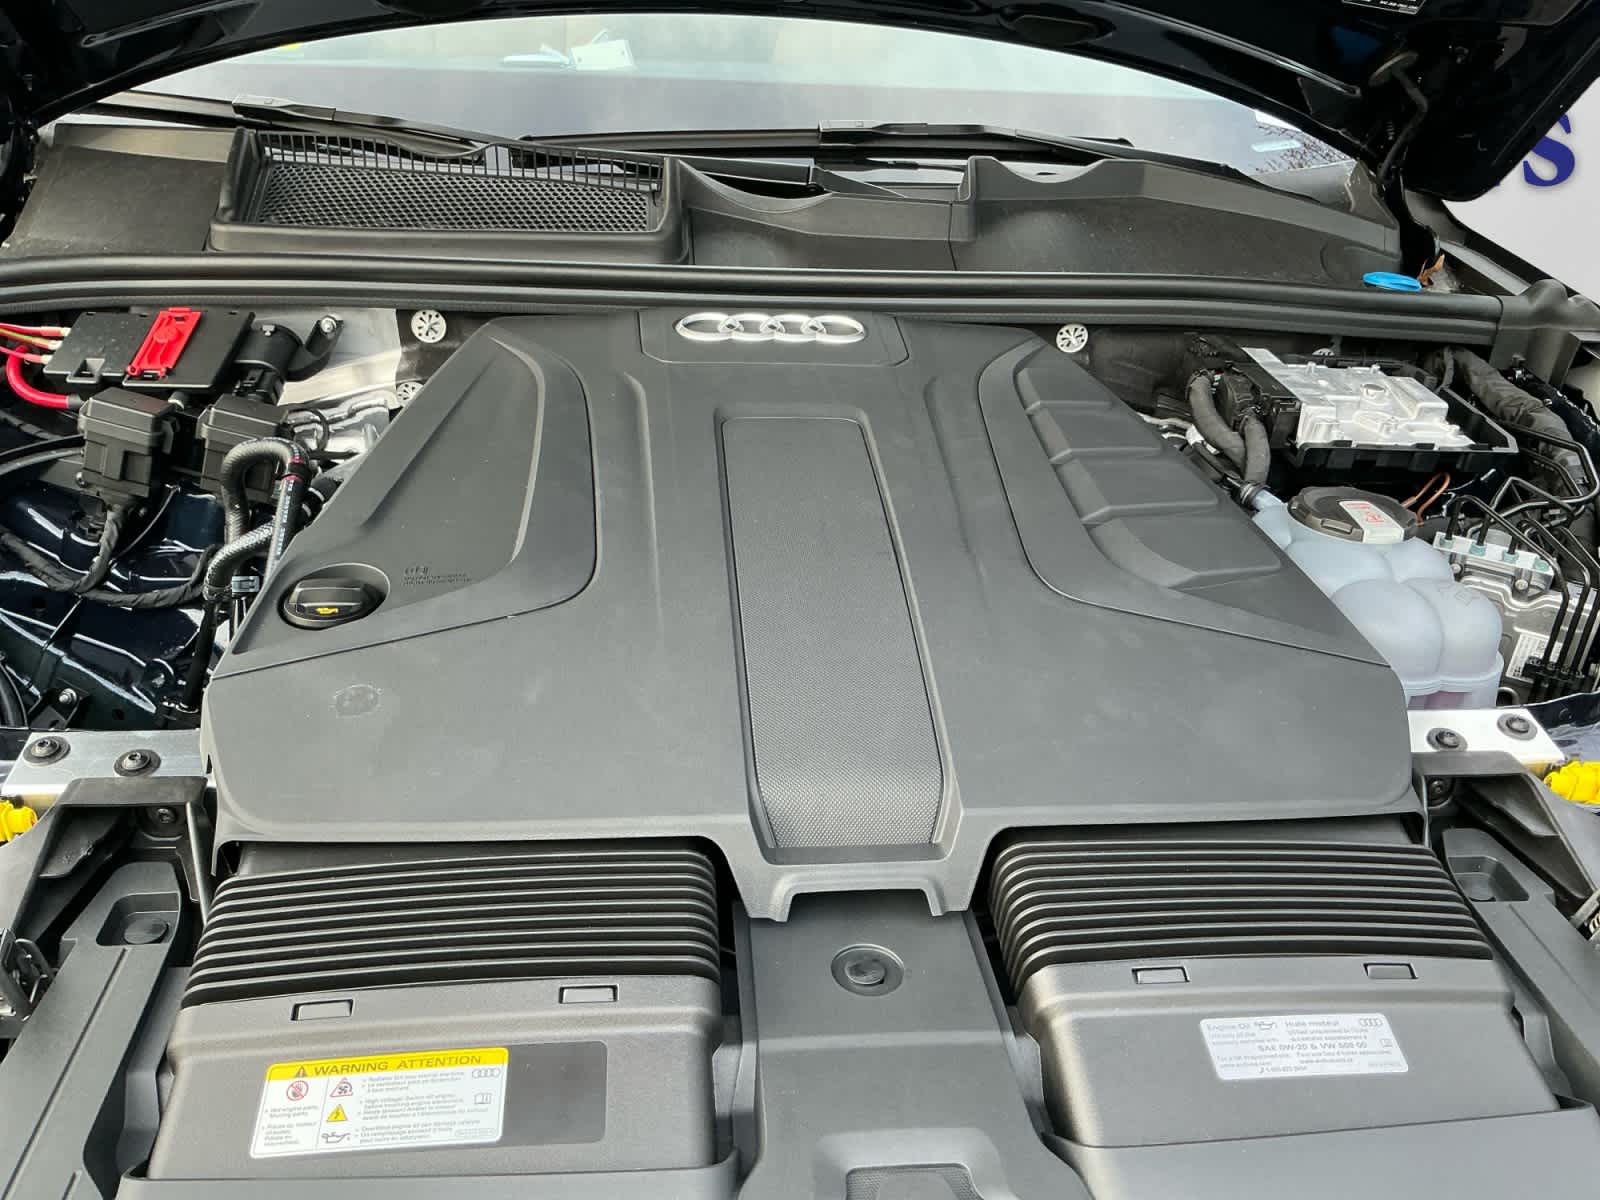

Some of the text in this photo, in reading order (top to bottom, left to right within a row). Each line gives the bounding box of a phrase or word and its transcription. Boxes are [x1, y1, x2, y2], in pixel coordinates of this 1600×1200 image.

[1494, 113, 1575, 187] S
[313, 1054, 482, 1076] WARNING ATTENTION
